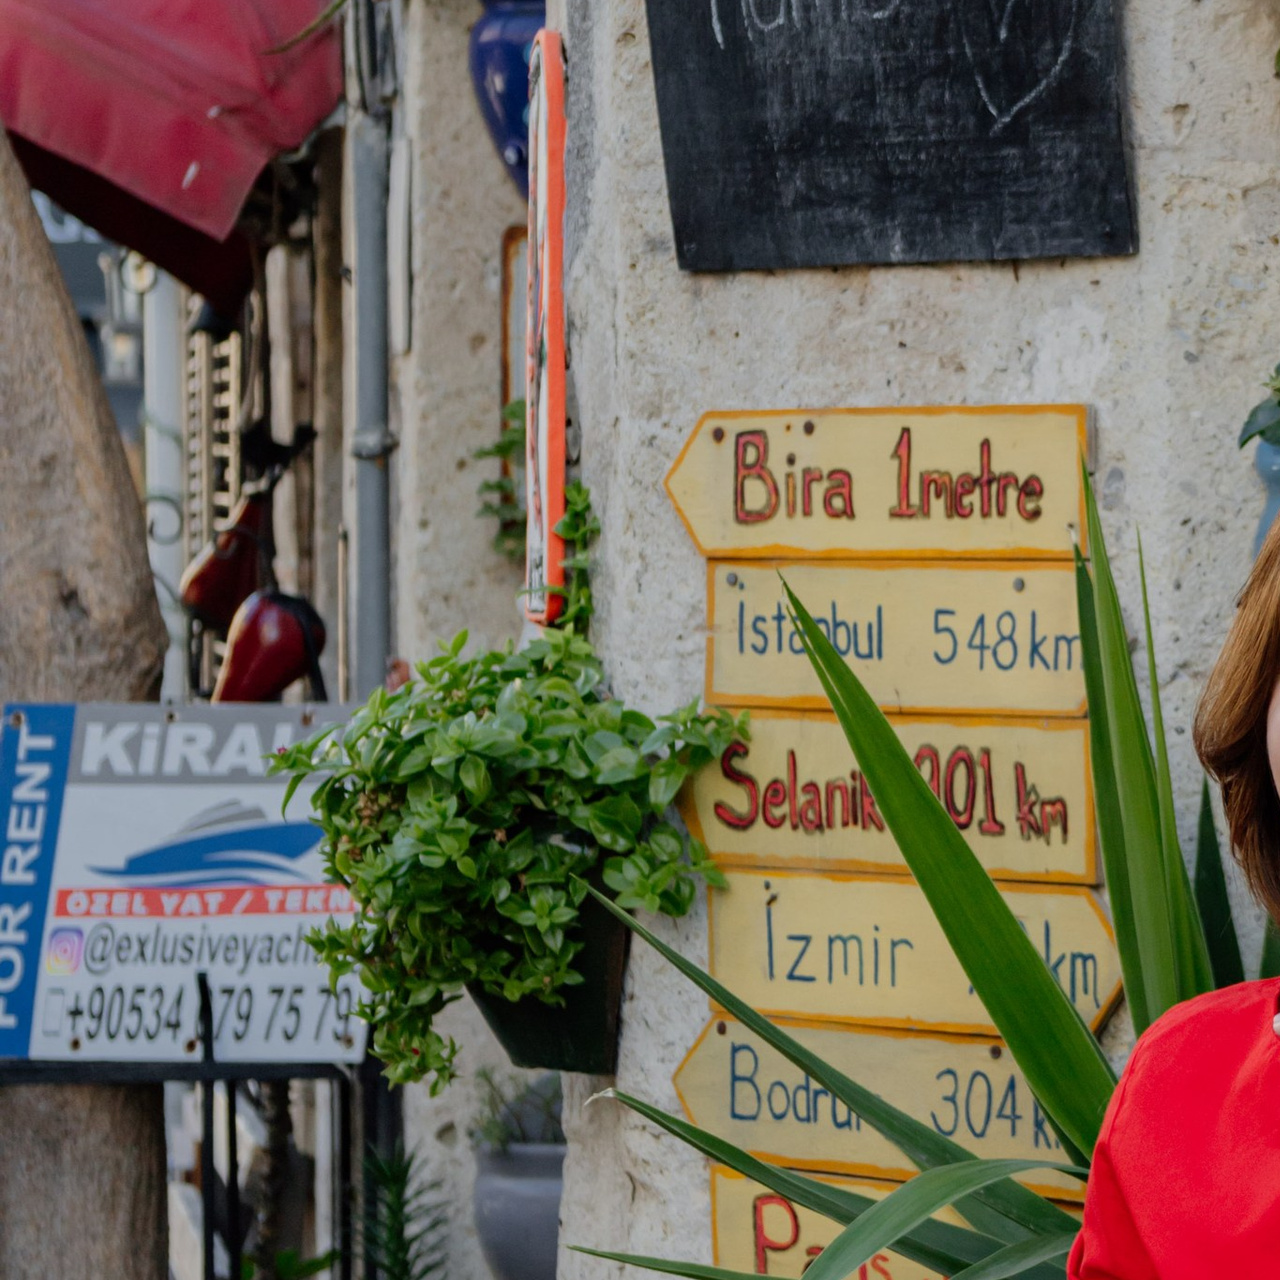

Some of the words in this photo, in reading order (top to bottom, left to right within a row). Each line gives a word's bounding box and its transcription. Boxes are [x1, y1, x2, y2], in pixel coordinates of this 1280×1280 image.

[734, 430, 855, 525] Bira
[1, 714, 56, 886] RENT
[714, 741, 886, 833] Selanik
[1014, 761, 1068, 846] km
[84, 922, 322, 976] @exlusiveyach
[160, 891, 225, 916] YAT
[263, 887, 362, 913] TEKN
[67, 983, 184, 1042] +90534
[196, 984, 252, 1042] 79
[730, 1042, 881, 1131] Bodru
[931, 1068, 1023, 1139] 304
[1033, 1098, 1062, 1149] k
